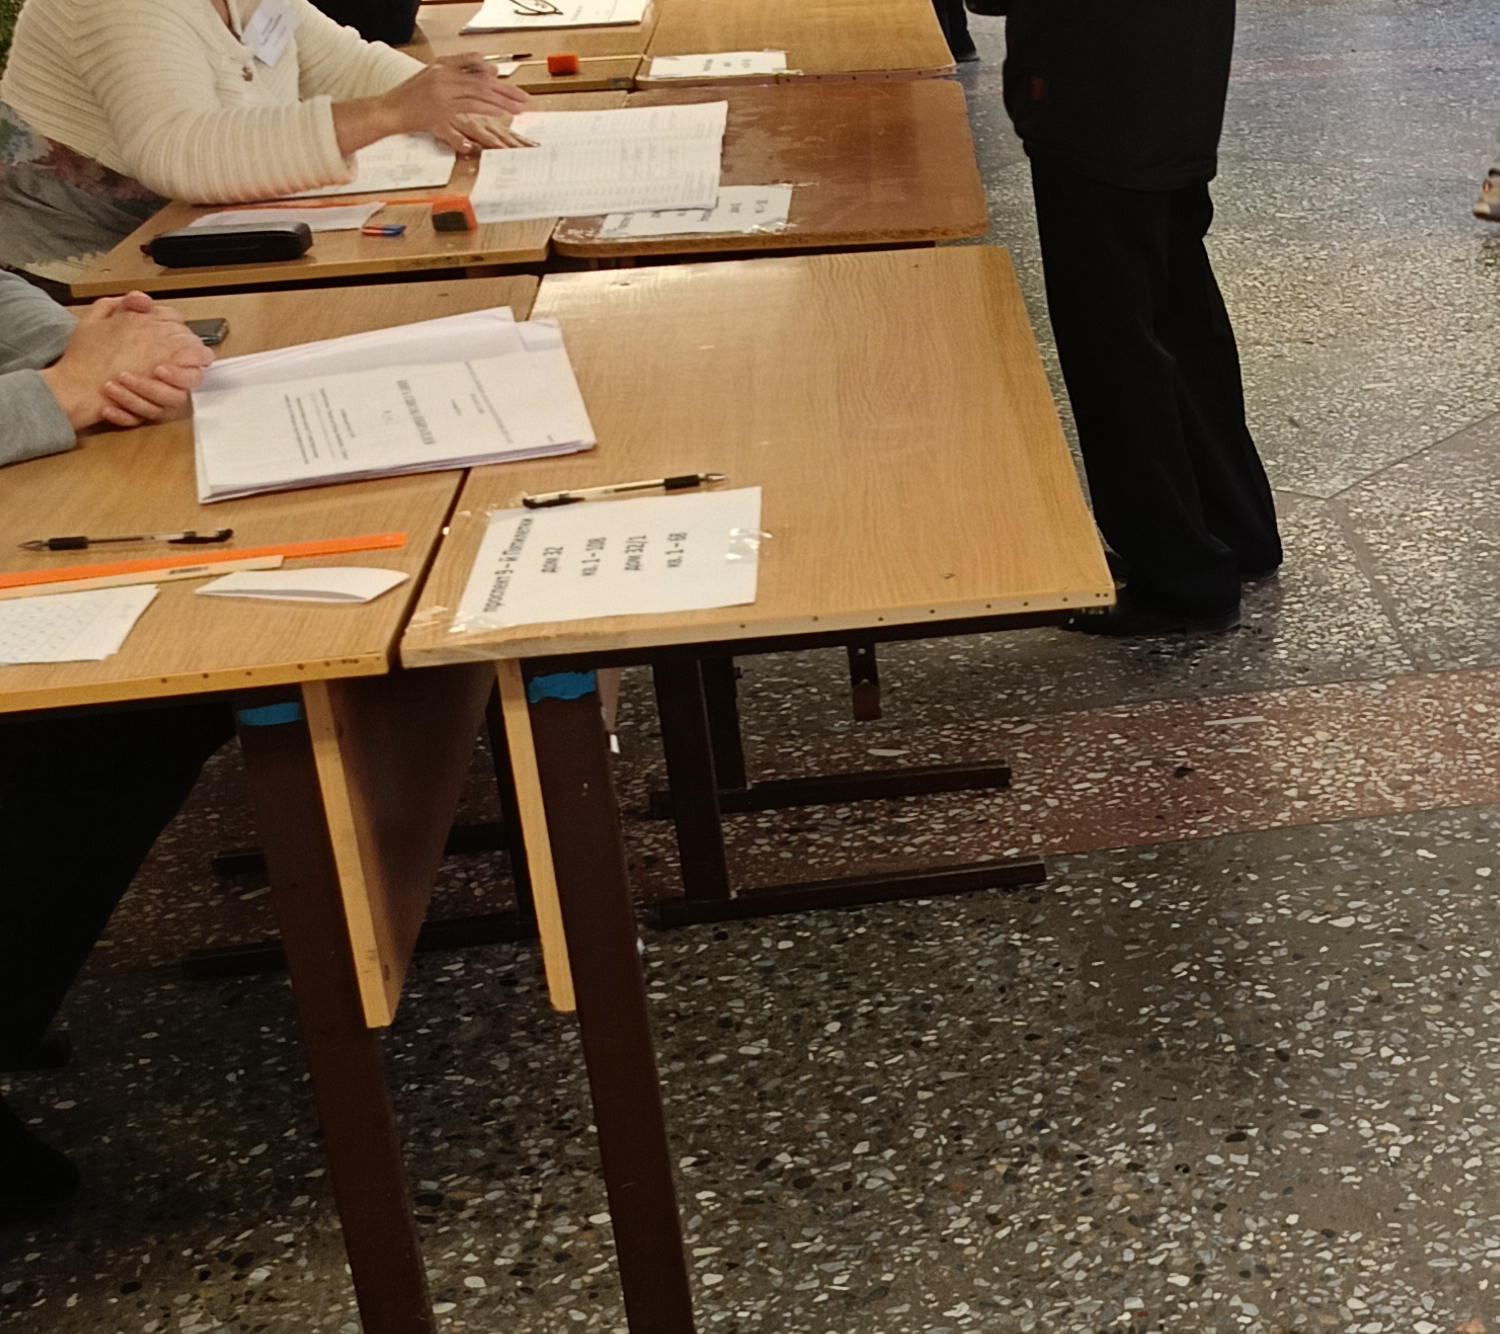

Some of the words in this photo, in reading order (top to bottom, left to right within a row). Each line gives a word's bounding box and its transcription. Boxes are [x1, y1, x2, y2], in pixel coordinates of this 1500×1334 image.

[542, 546, 563, 556] 32
[624, 534, 648, 553] 32/1
[483, 575, 511, 613] проспект
[502, 517, 533, 555] Пятилетки
[541, 557, 560, 574] дом
[624, 554, 643, 571] дом
